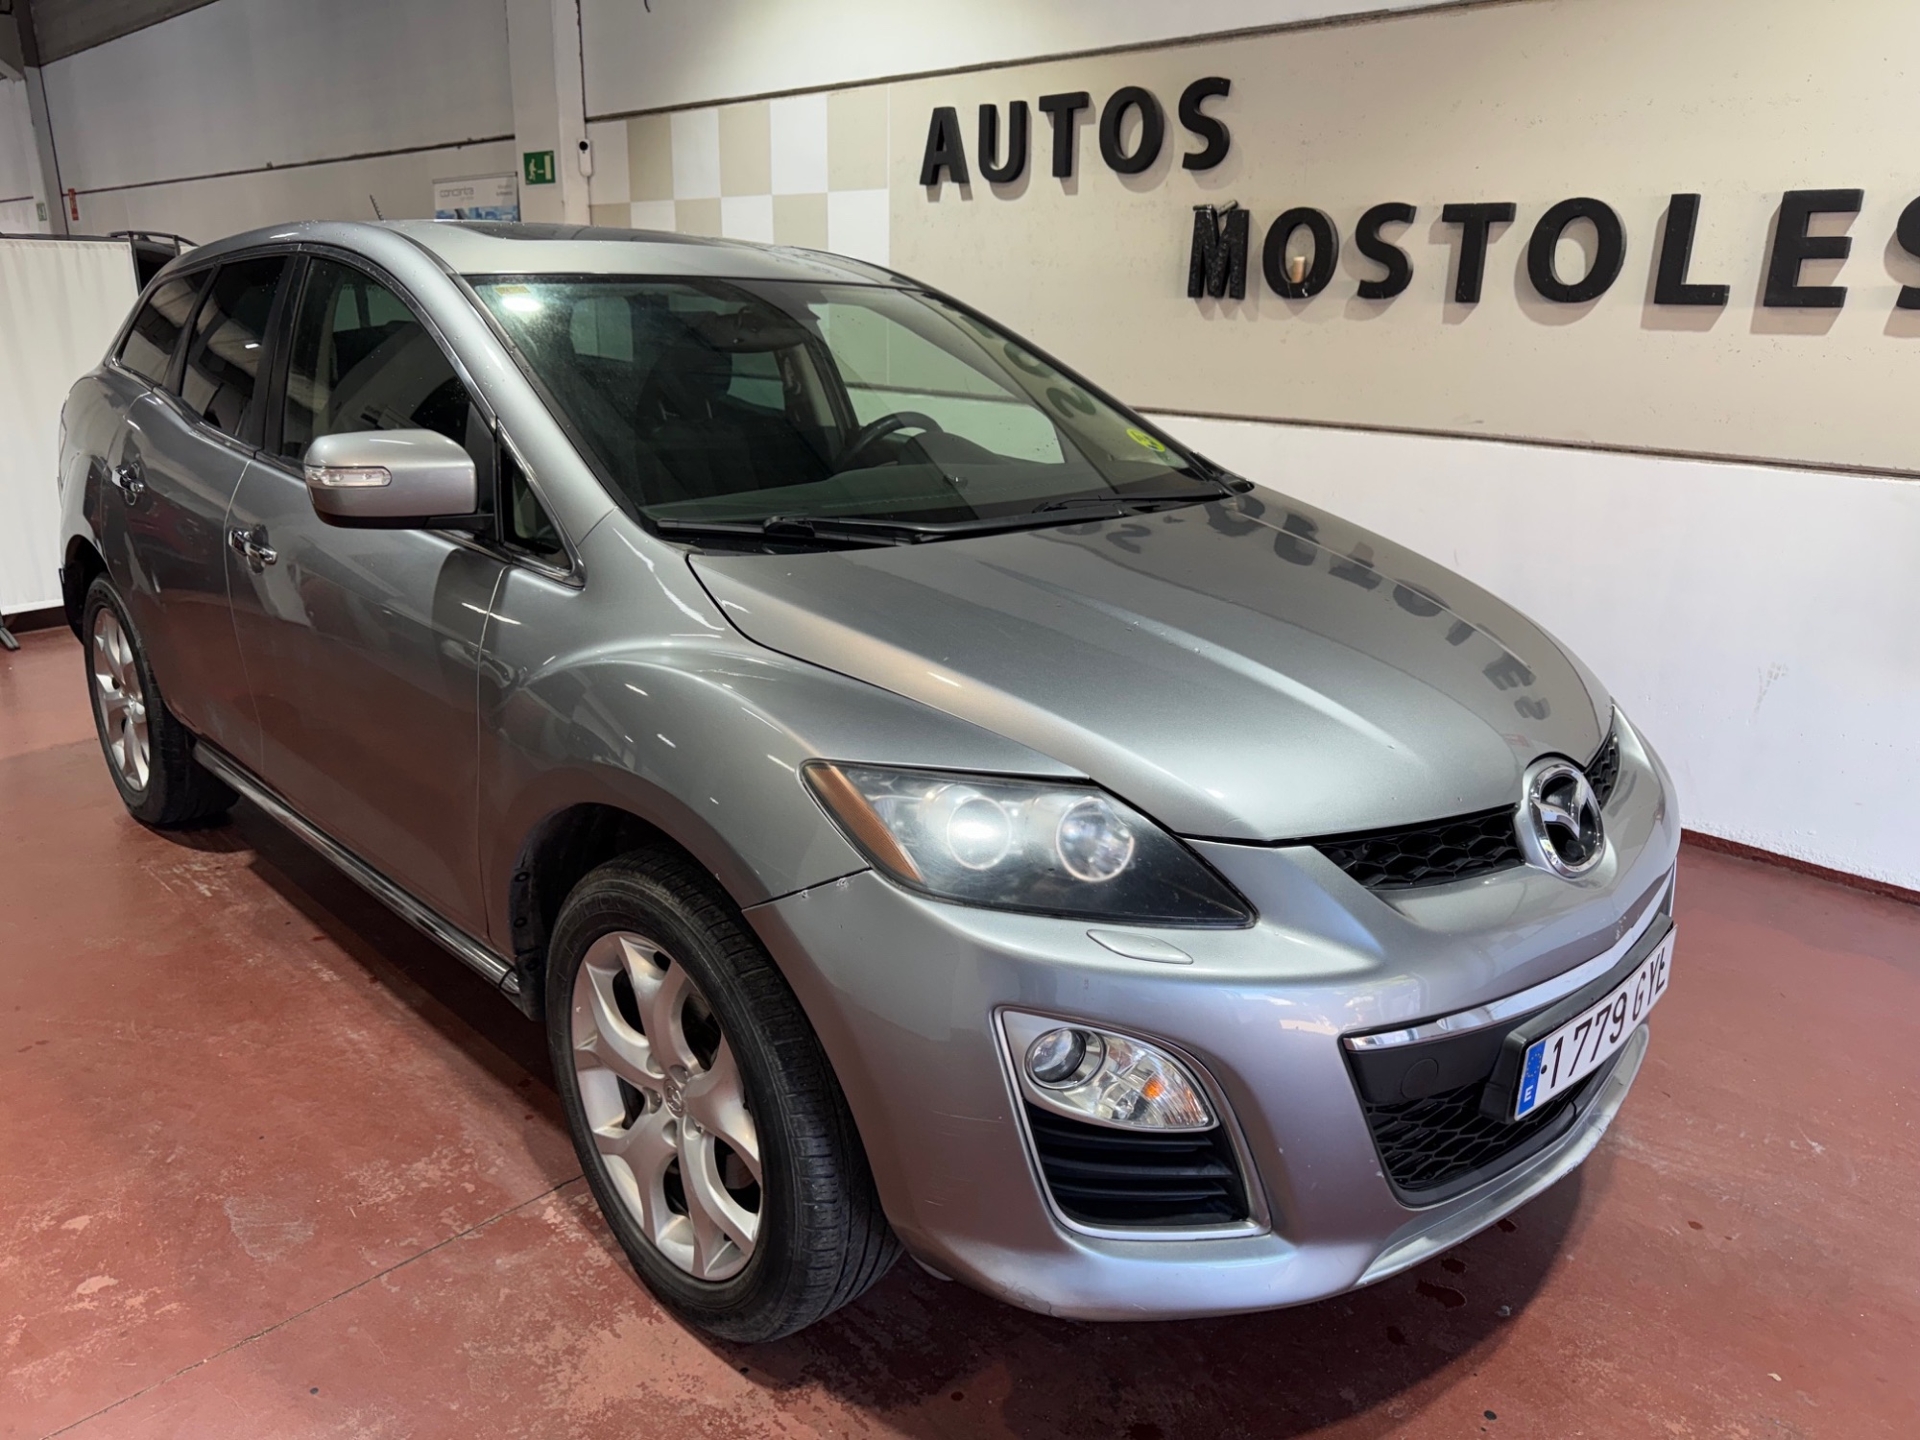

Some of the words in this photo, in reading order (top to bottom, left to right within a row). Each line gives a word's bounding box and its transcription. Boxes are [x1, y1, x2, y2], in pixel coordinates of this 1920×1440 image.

[919, 76, 1232, 186] AUTOS
[1187, 188, 1920, 309] MOSTOLE
[1550, 991, 1628, 1089] 1779
